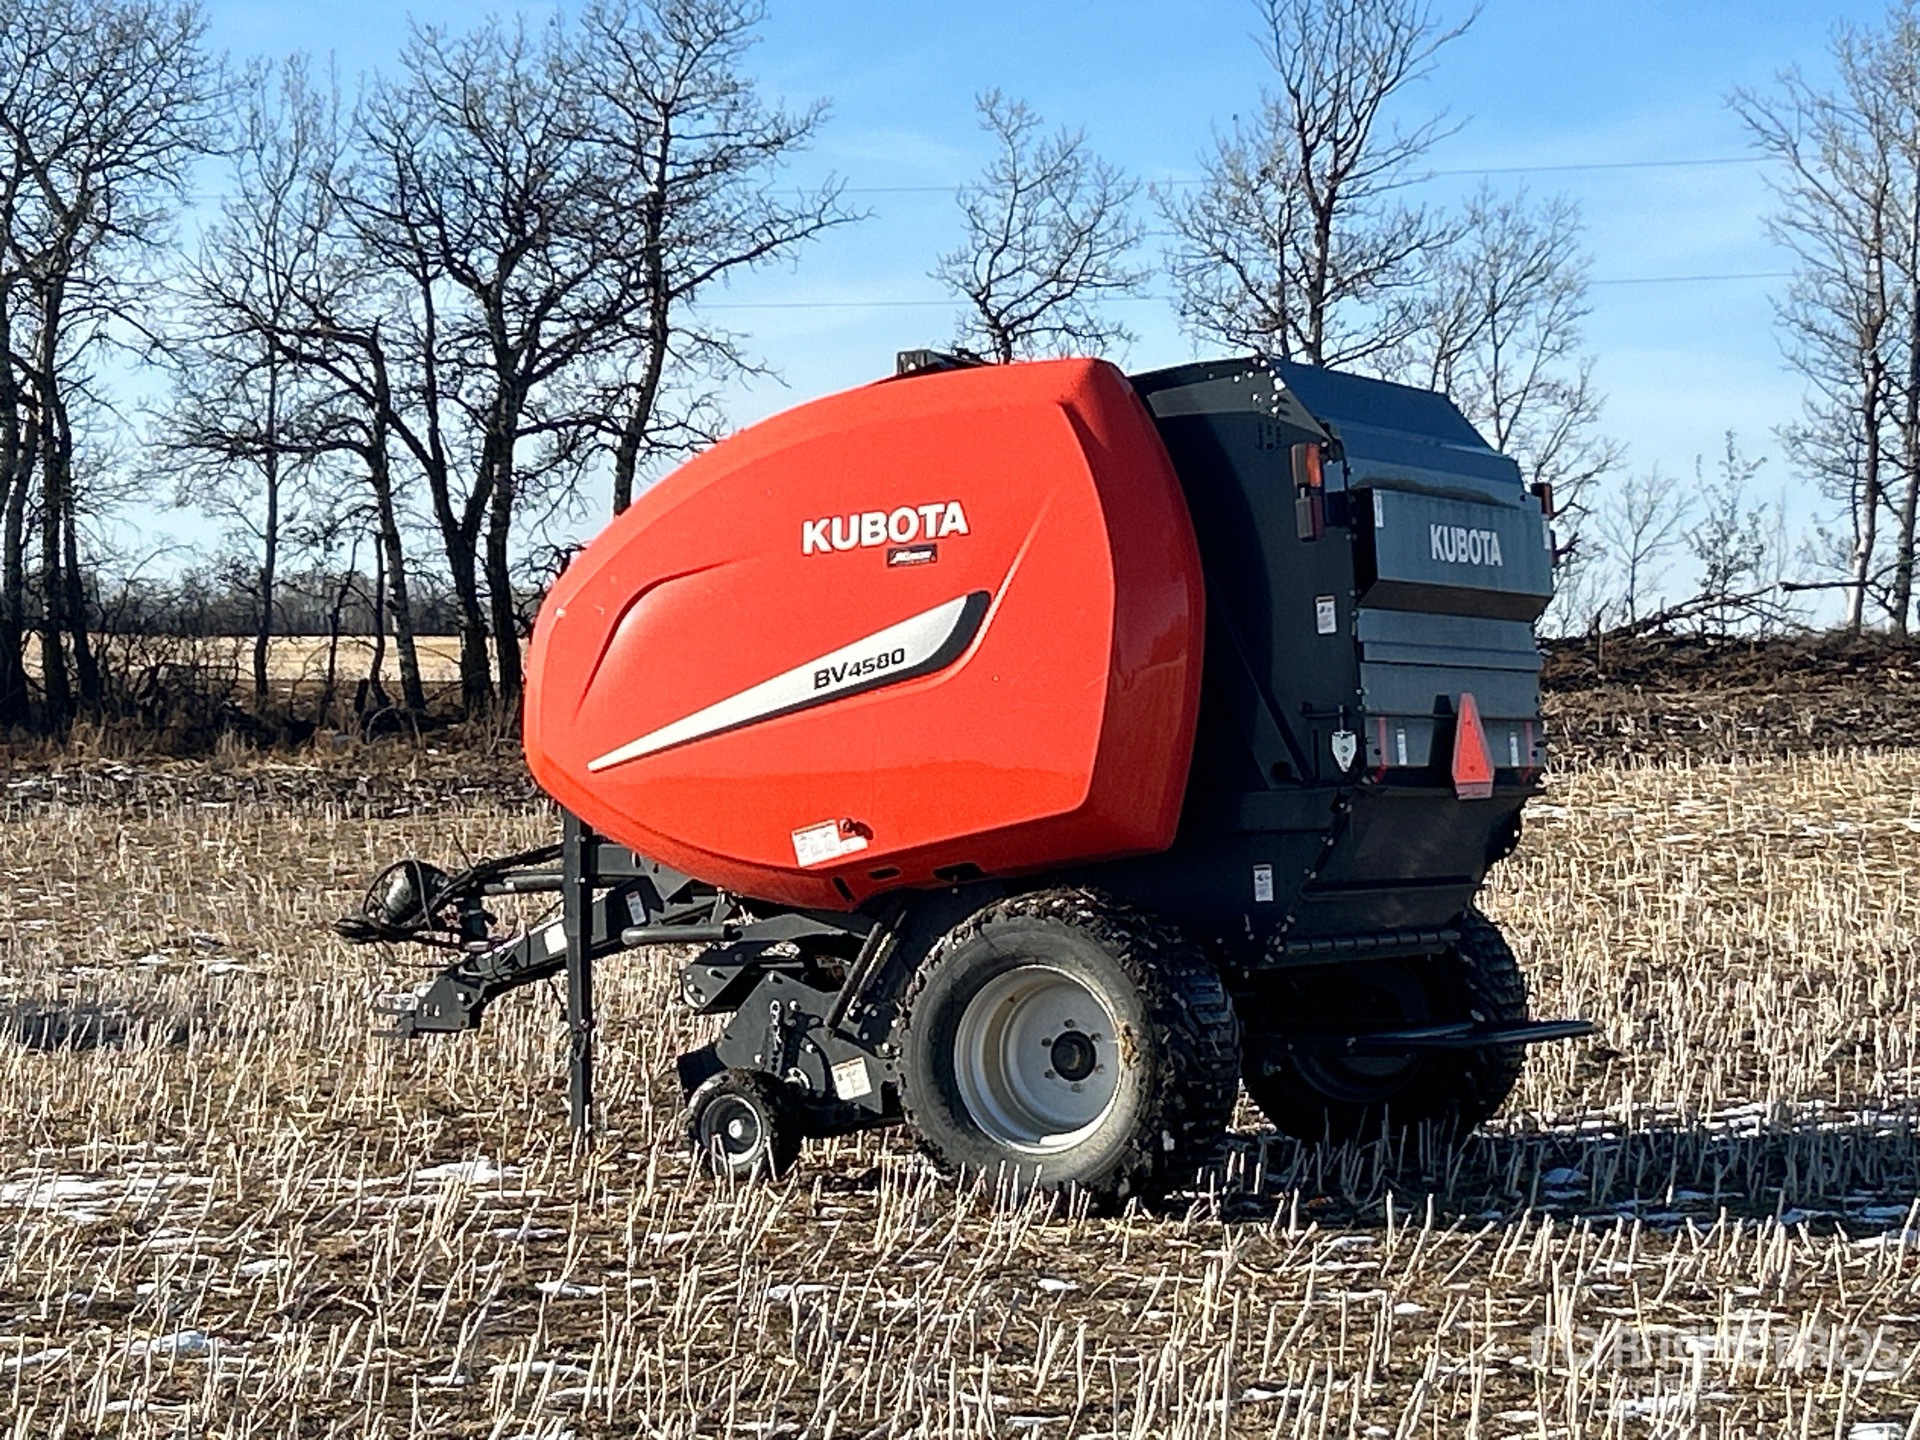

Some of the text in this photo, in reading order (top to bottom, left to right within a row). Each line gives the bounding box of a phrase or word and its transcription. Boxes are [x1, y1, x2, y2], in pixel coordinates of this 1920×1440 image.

[802, 500, 970, 555] KUBOTA
[1430, 523, 1503, 567] KUBOTA
[813, 648, 905, 690] BV4580
